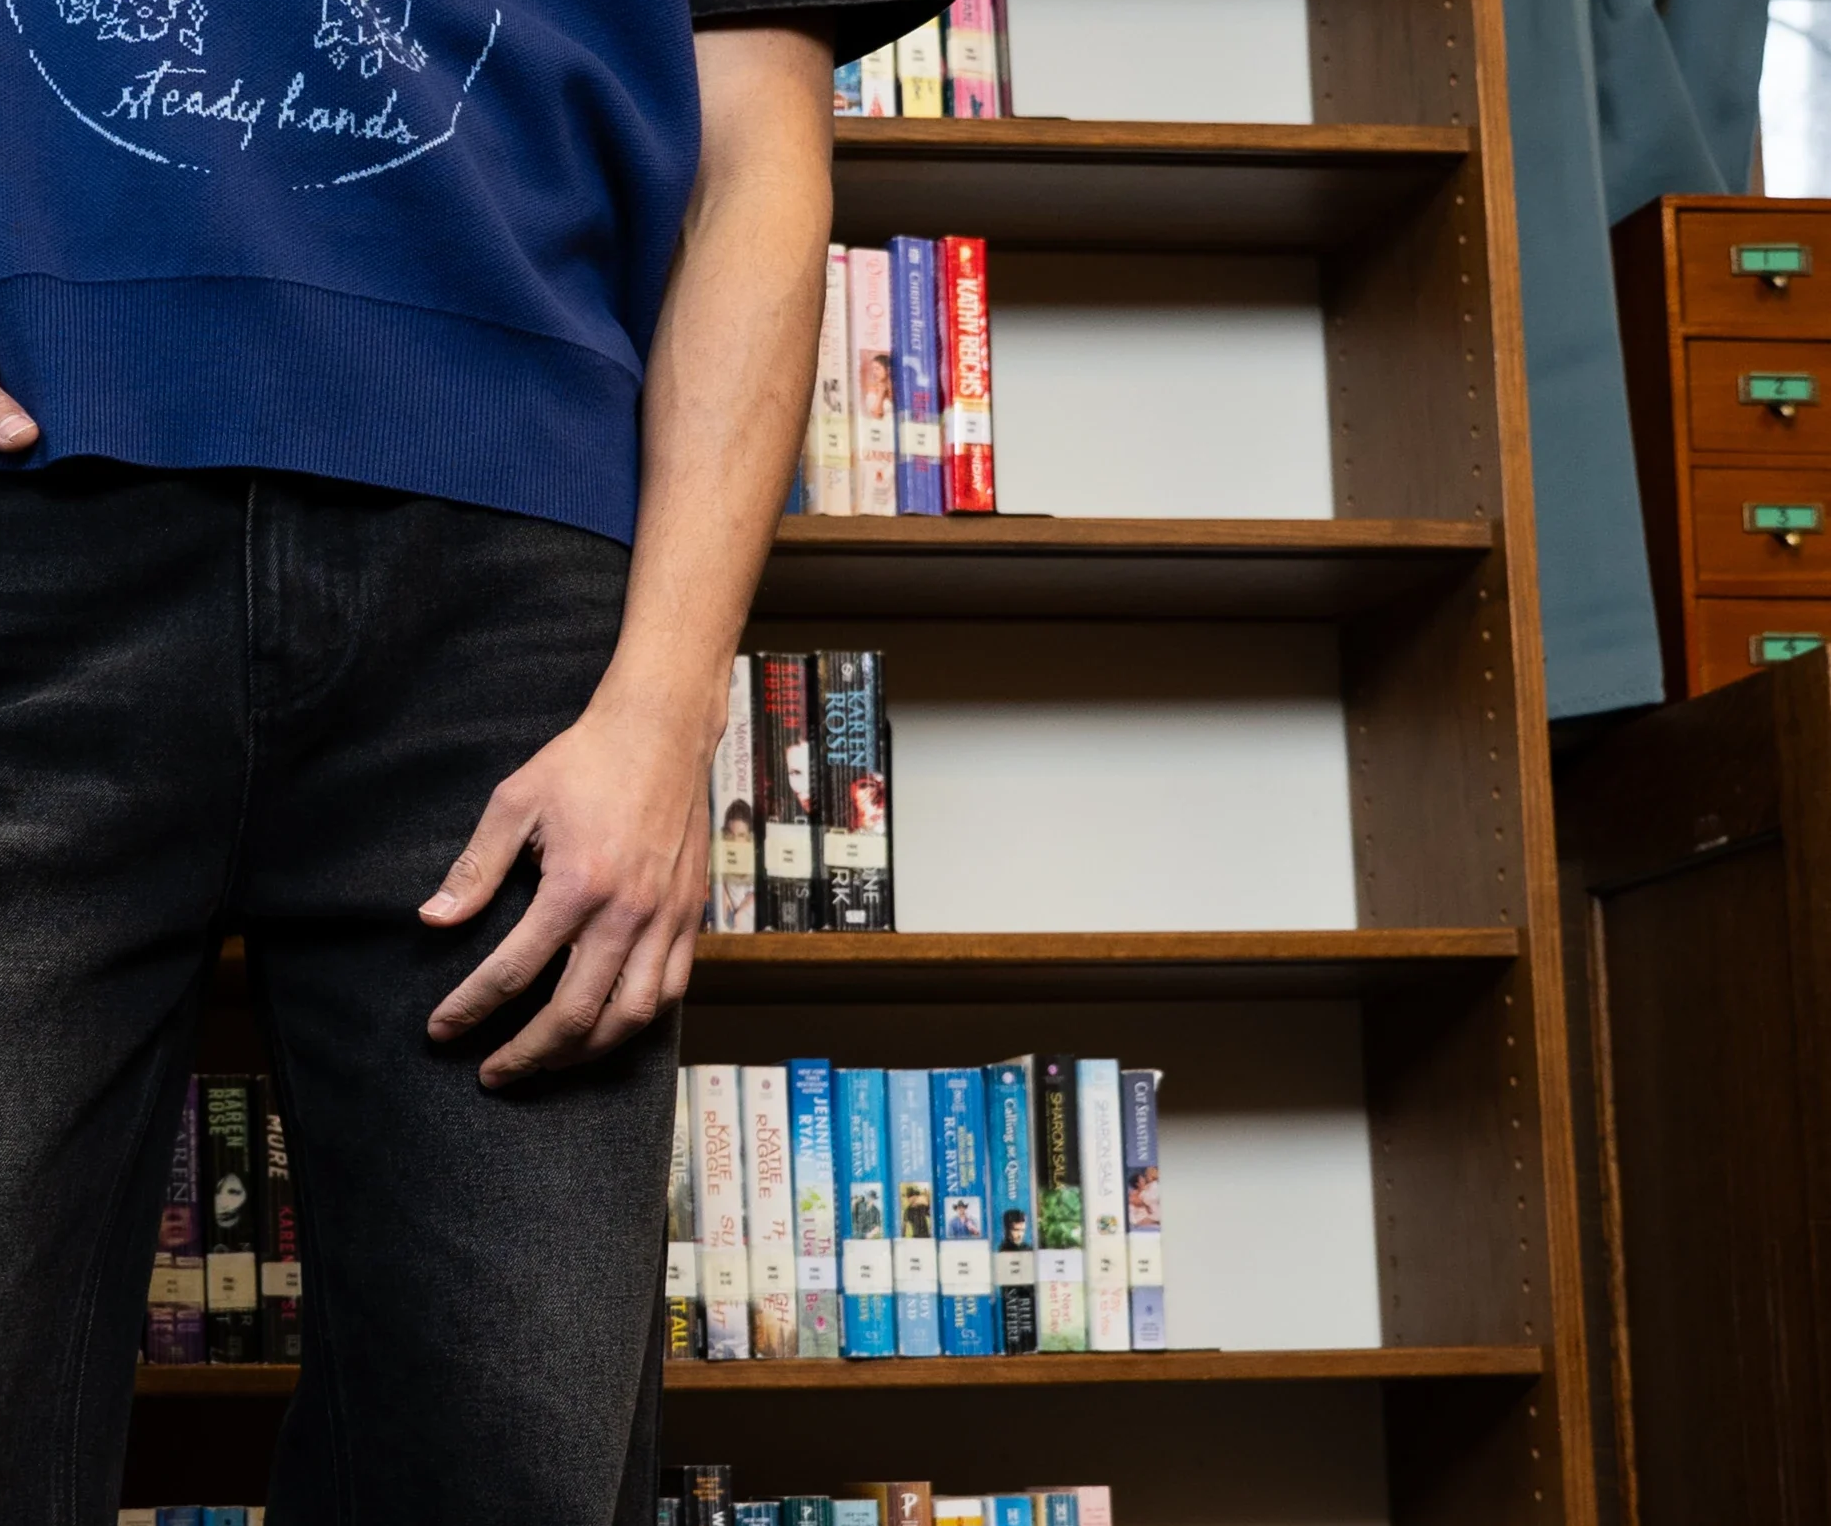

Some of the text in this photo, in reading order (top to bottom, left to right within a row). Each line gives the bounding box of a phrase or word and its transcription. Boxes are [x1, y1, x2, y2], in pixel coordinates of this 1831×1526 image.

[103, 60, 418, 149] steady hands
[955, 279, 983, 394] KATHY REICHS
[825, 692, 847, 765] ROSE
[845, 690, 872, 767] KAREN
[756, 1115, 771, 1198] RUGGLE
[767, 1129, 782, 1183] KATIE
[798, 1116, 812, 1164] RYAN
[813, 1097, 829, 1179] JENNIFER
[1050, 1093, 1067, 1190] SHARON SALA
[1134, 1082, 1152, 1160] CAT SEBASTIAN
